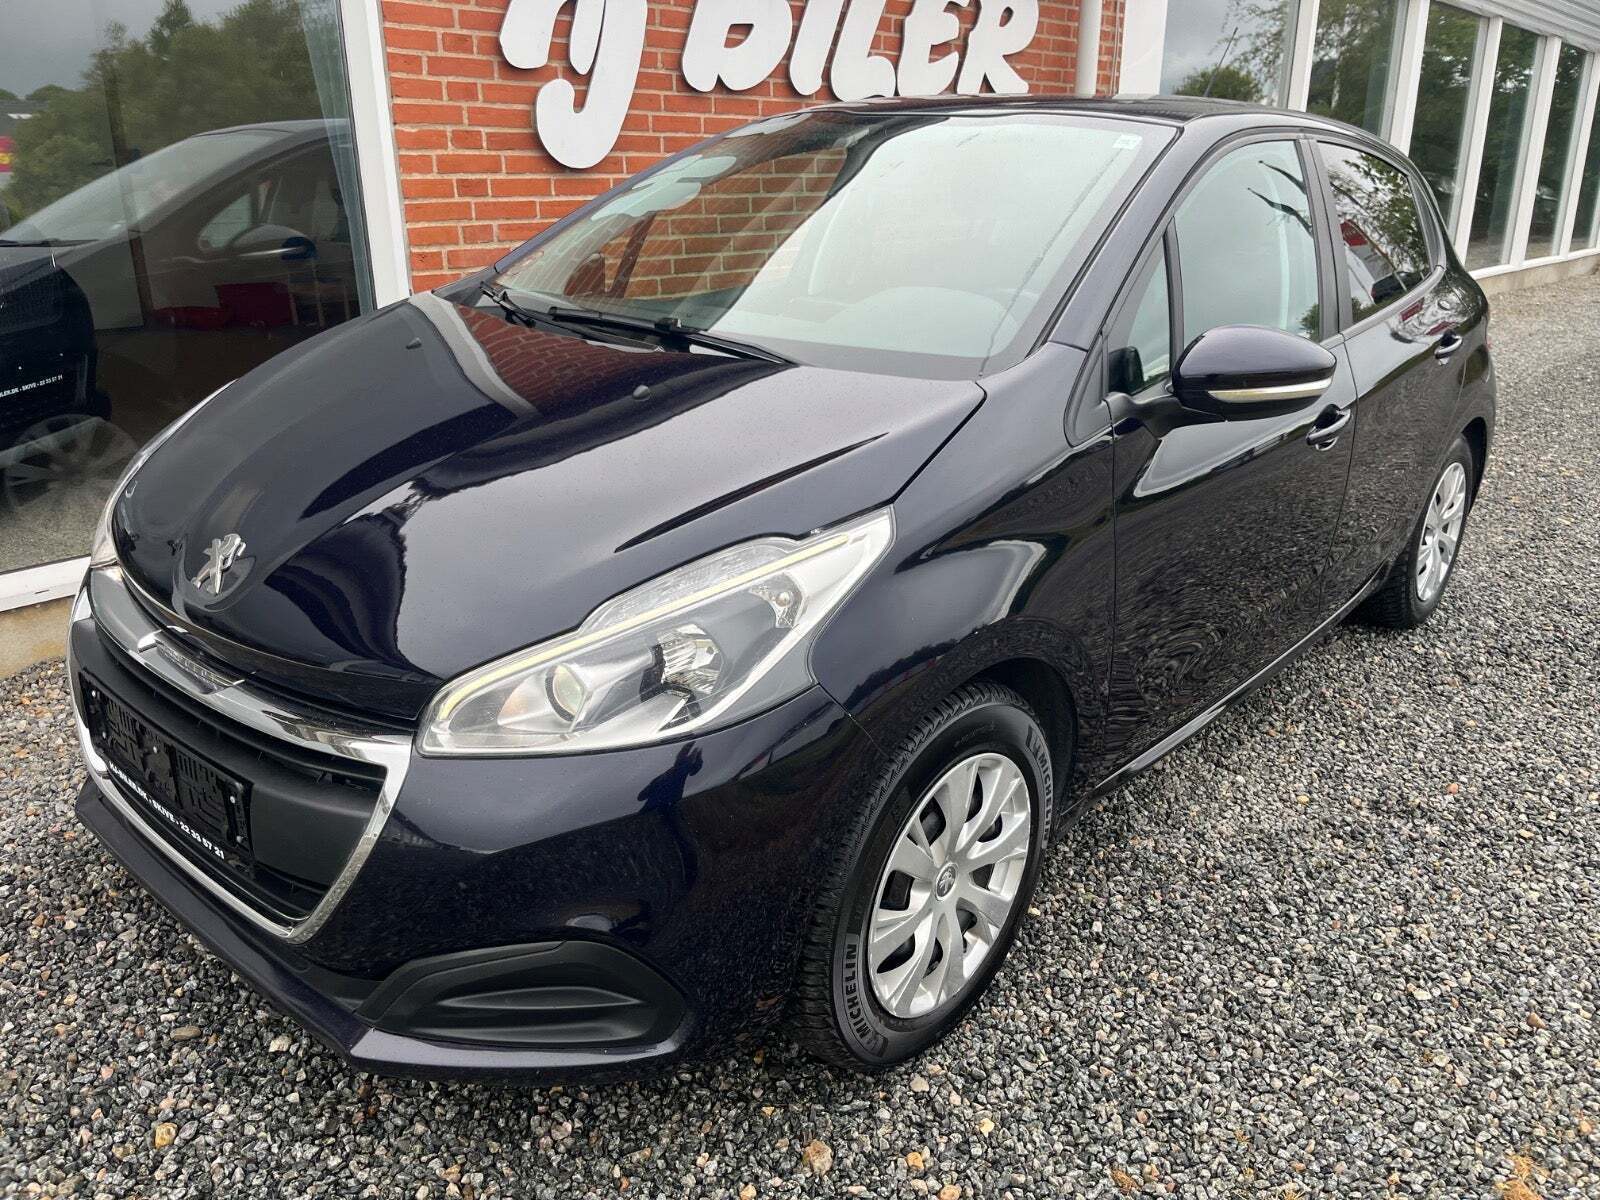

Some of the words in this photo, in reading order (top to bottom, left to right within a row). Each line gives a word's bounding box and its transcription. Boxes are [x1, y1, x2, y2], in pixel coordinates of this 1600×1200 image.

[152, 799, 175, 823] SKIVE
[179, 821, 191, 835] 22
[214, 846, 225, 860] 21
[1037, 751, 1052, 841] MICHELIN
[845, 943, 871, 1040] MICHELIN
